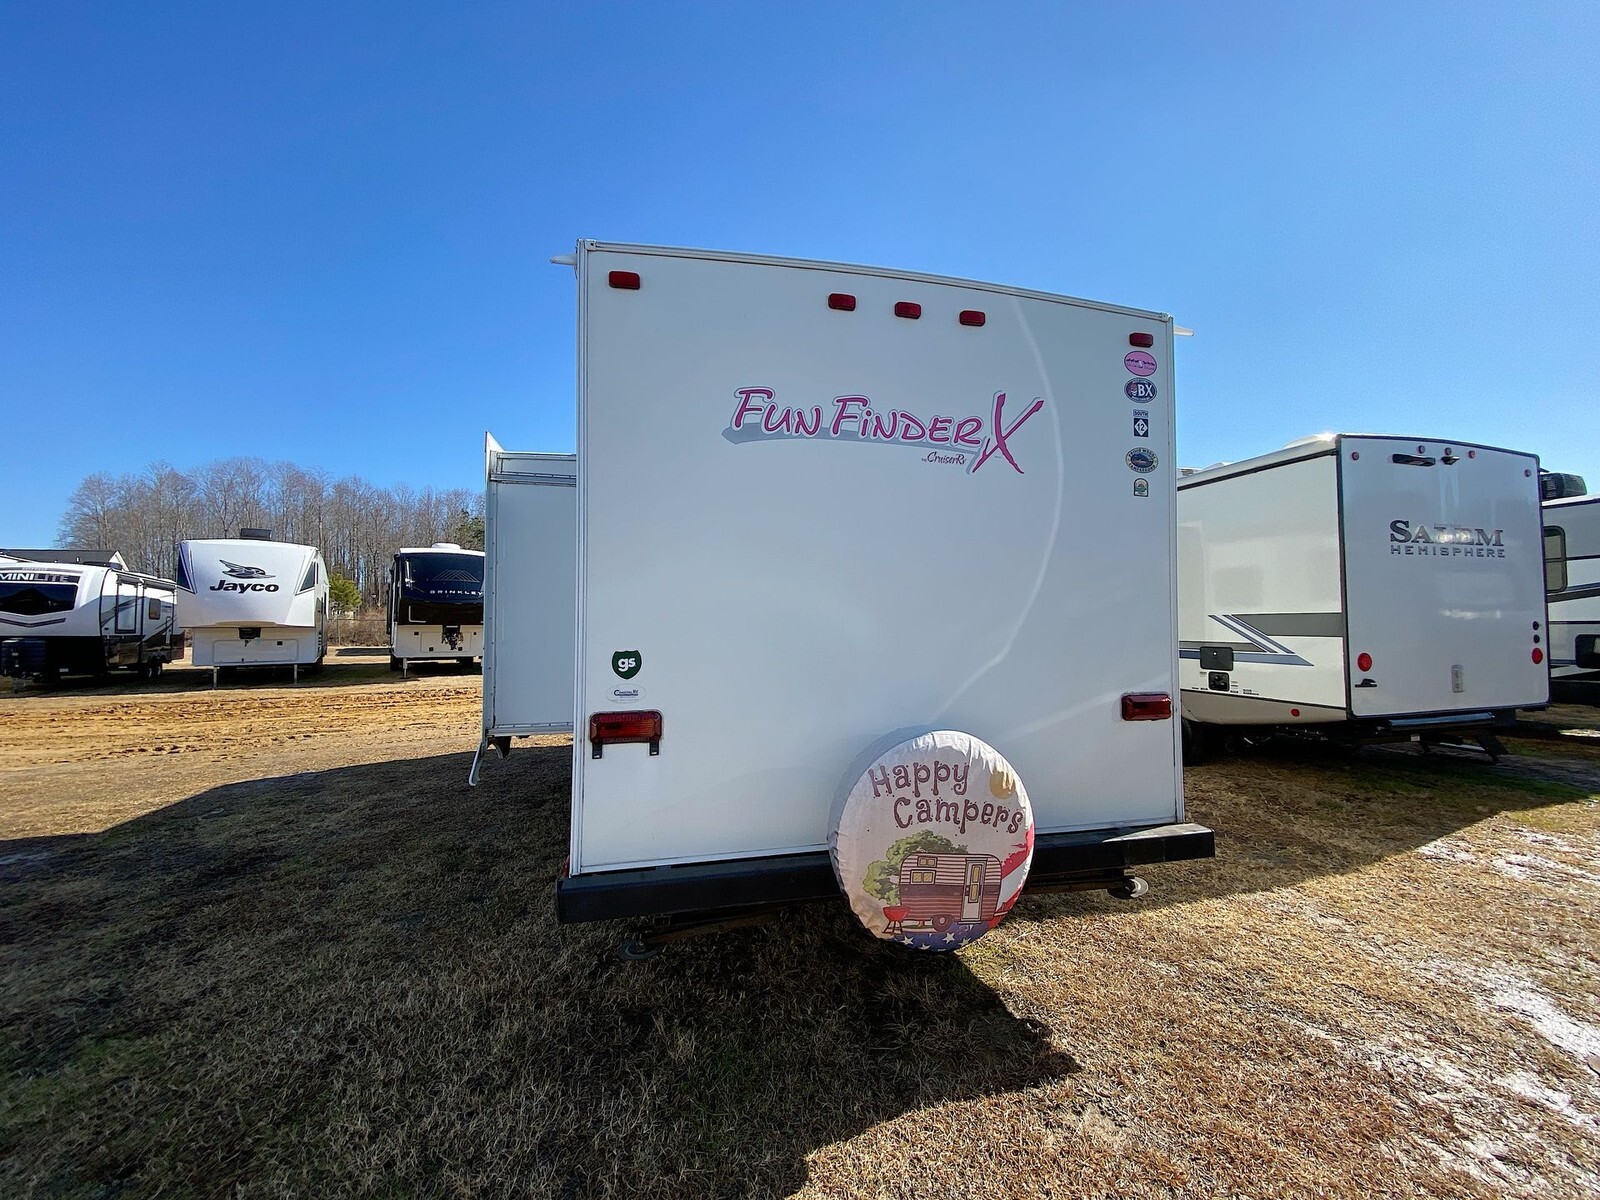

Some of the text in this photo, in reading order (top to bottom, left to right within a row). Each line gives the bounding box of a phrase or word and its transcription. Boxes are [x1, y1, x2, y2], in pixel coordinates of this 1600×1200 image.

[734, 388, 821, 436] FUN
[1137, 423, 1145, 431] 12
[1390, 519, 1504, 546] SALEM
[1391, 545, 1505, 558] HEMISPHERE
[209, 579, 279, 594] Jayco
[617, 657, 636, 672] gs
[867, 760, 970, 798] Happy
[893, 797, 1024, 834] Campers
